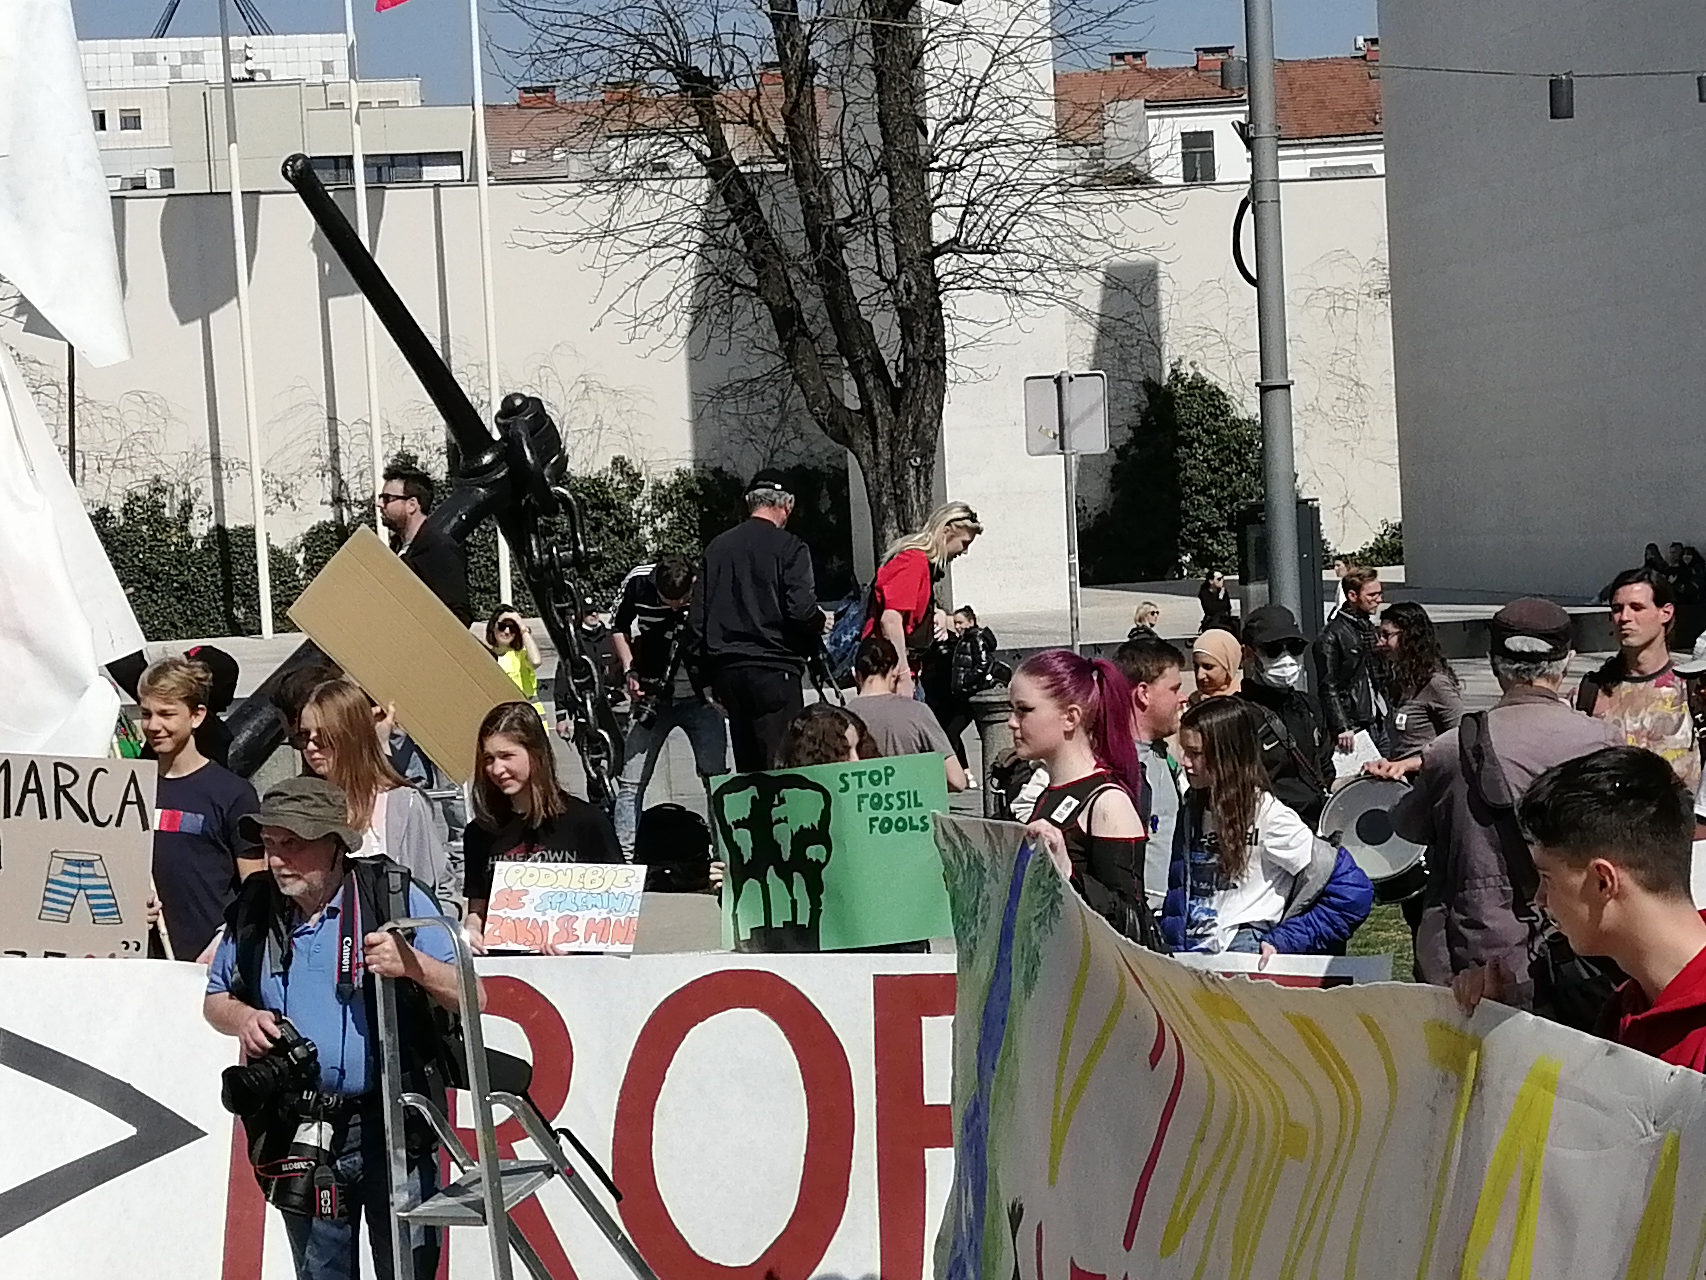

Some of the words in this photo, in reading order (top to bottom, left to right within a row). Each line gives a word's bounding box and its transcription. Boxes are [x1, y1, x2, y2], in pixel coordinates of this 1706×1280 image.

[838, 765, 896, 793] STOP
[856, 789, 924, 813] FOSSIL
[868, 814, 930, 835] FOOLS
[503, 863, 636, 893] PODNEBJE
[490, 887, 531, 912] SE
[551, 914, 580, 946] SE
[341, 936, 353, 974] Canon
[1047, 900, 1128, 1188] V
[281, 1160, 316, 1172] Canon
[320, 1189, 332, 1215] EOS
